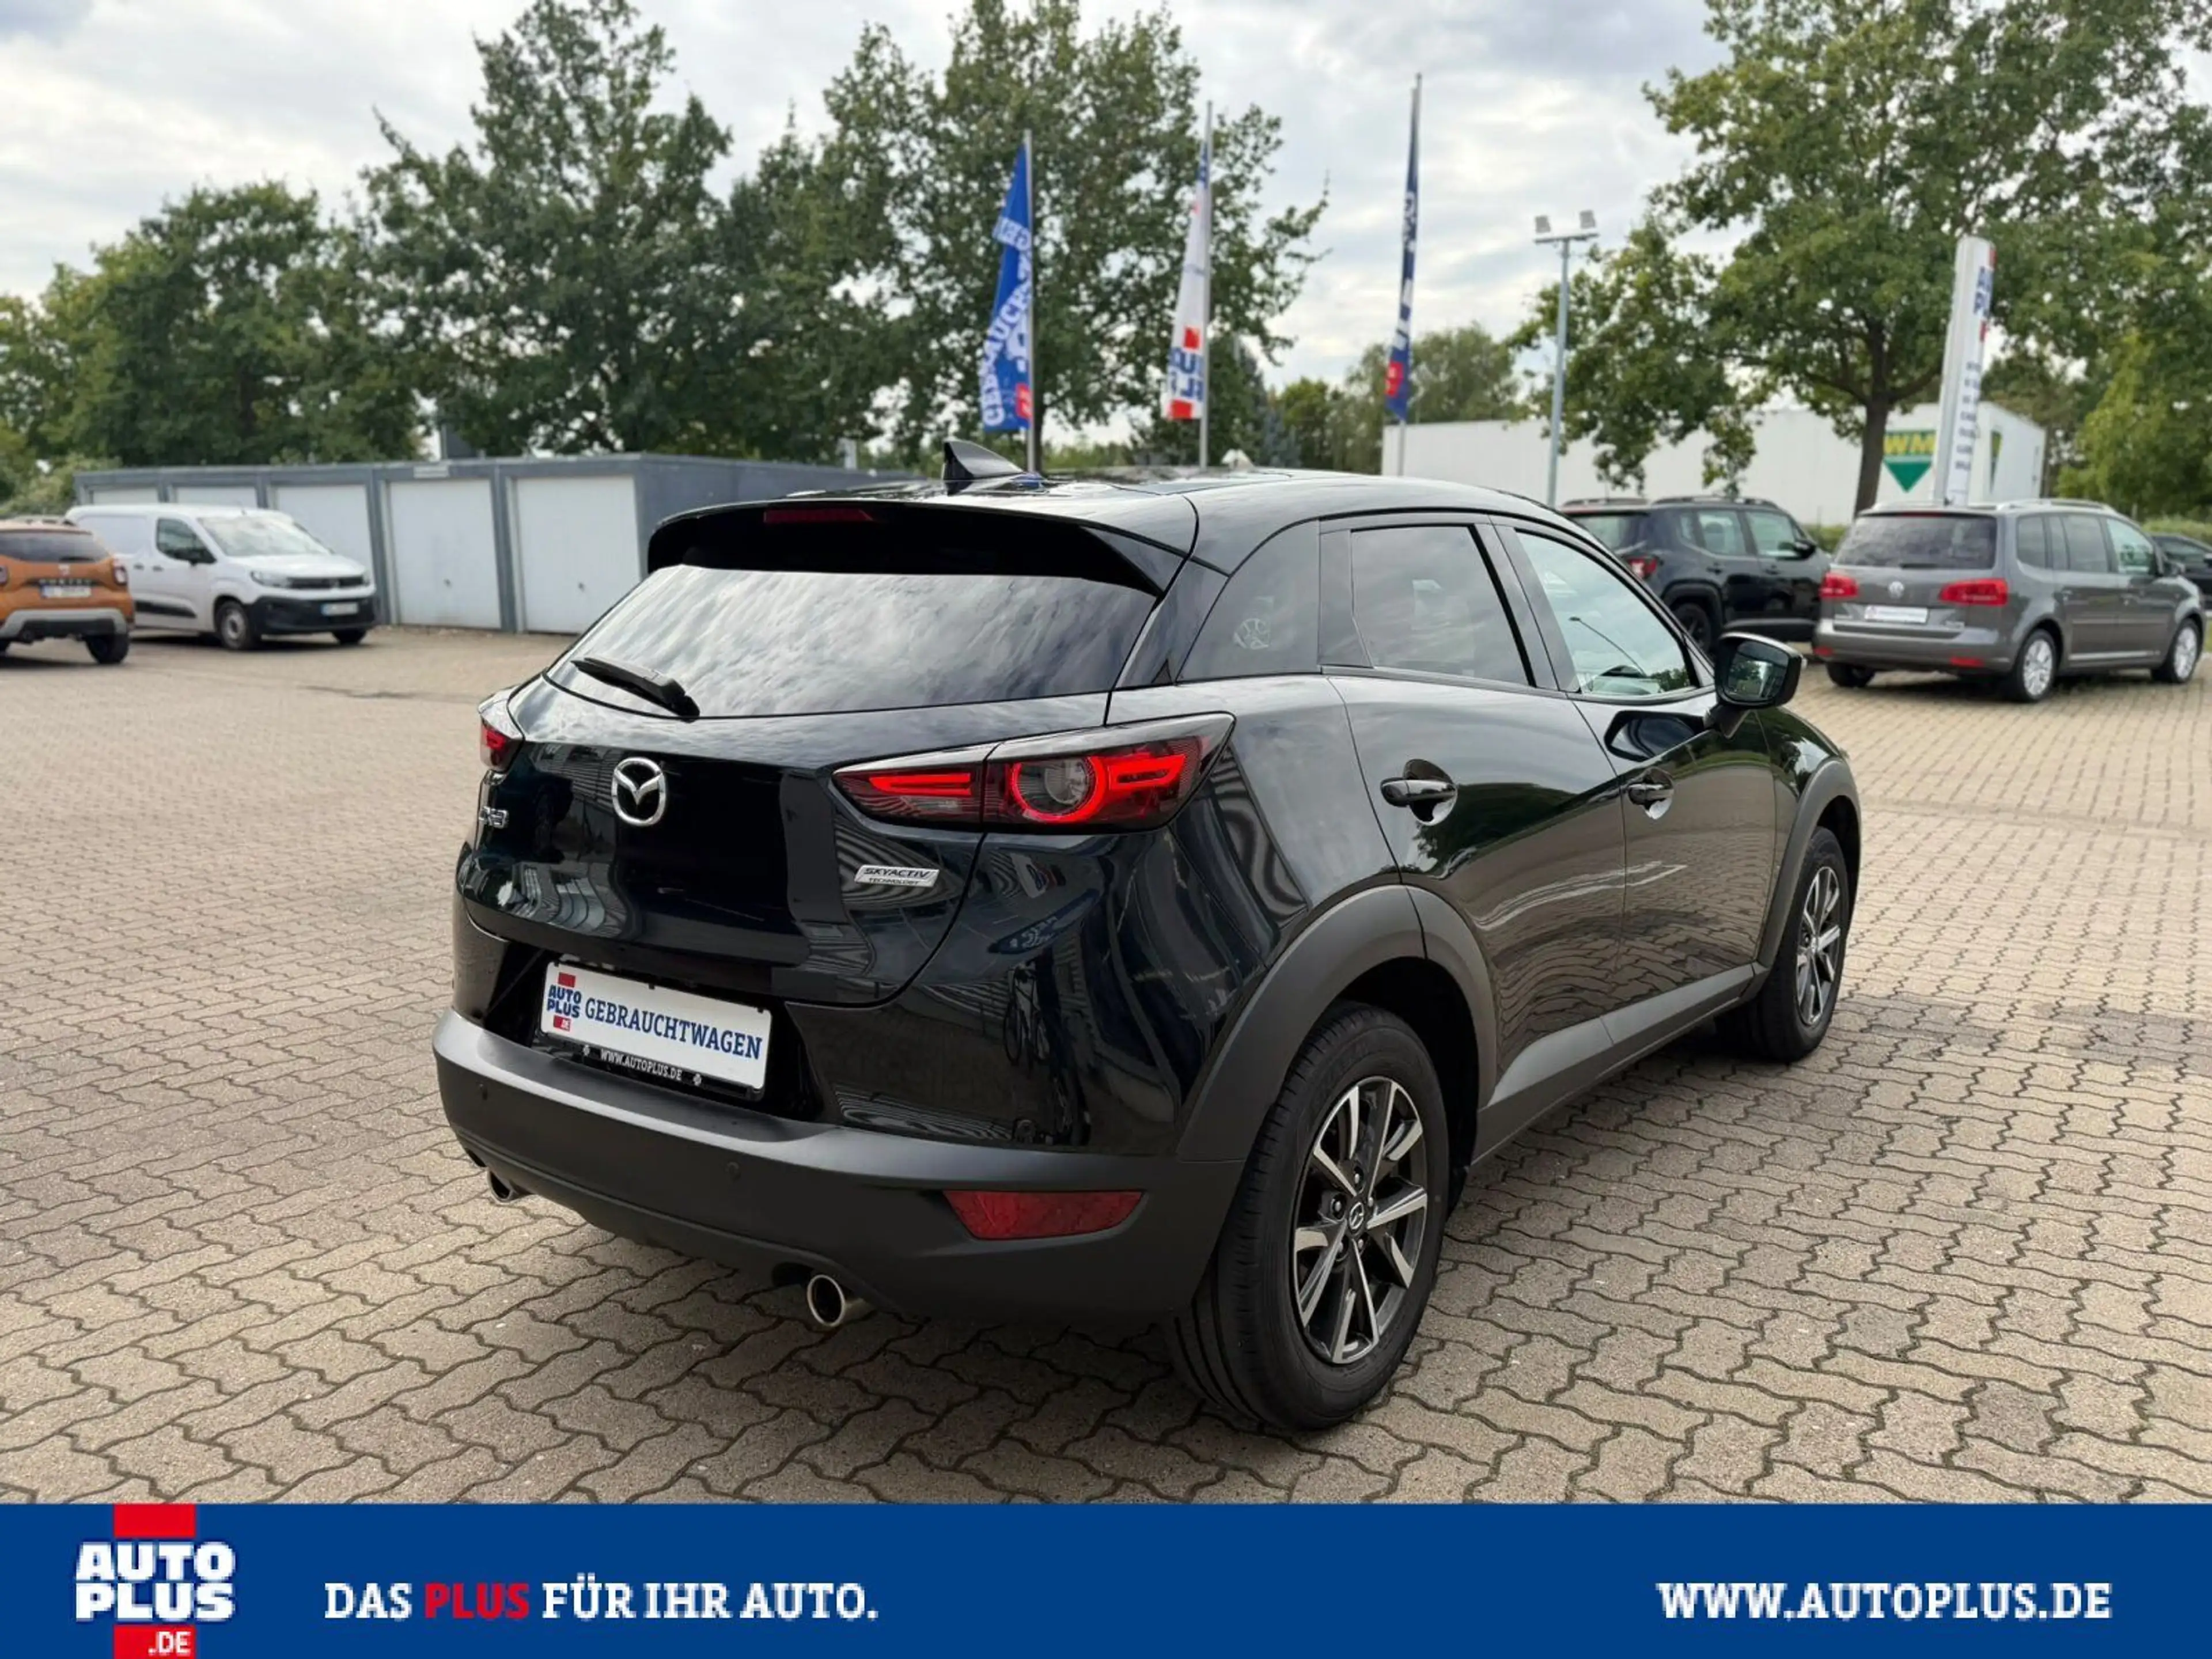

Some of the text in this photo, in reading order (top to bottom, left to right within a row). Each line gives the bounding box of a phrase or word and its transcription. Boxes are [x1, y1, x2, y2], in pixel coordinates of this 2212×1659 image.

[1884, 433, 1936, 454] WM
[863, 868, 930, 878] SKYACTIV
[548, 984, 582, 1004] AUTO
[547, 998, 581, 1018] PLUS
[585, 998, 763, 1060] GEBRAUCHTWAGEN
[600, 1048, 683, 1081] WWW.AUTOPLUS.DE
